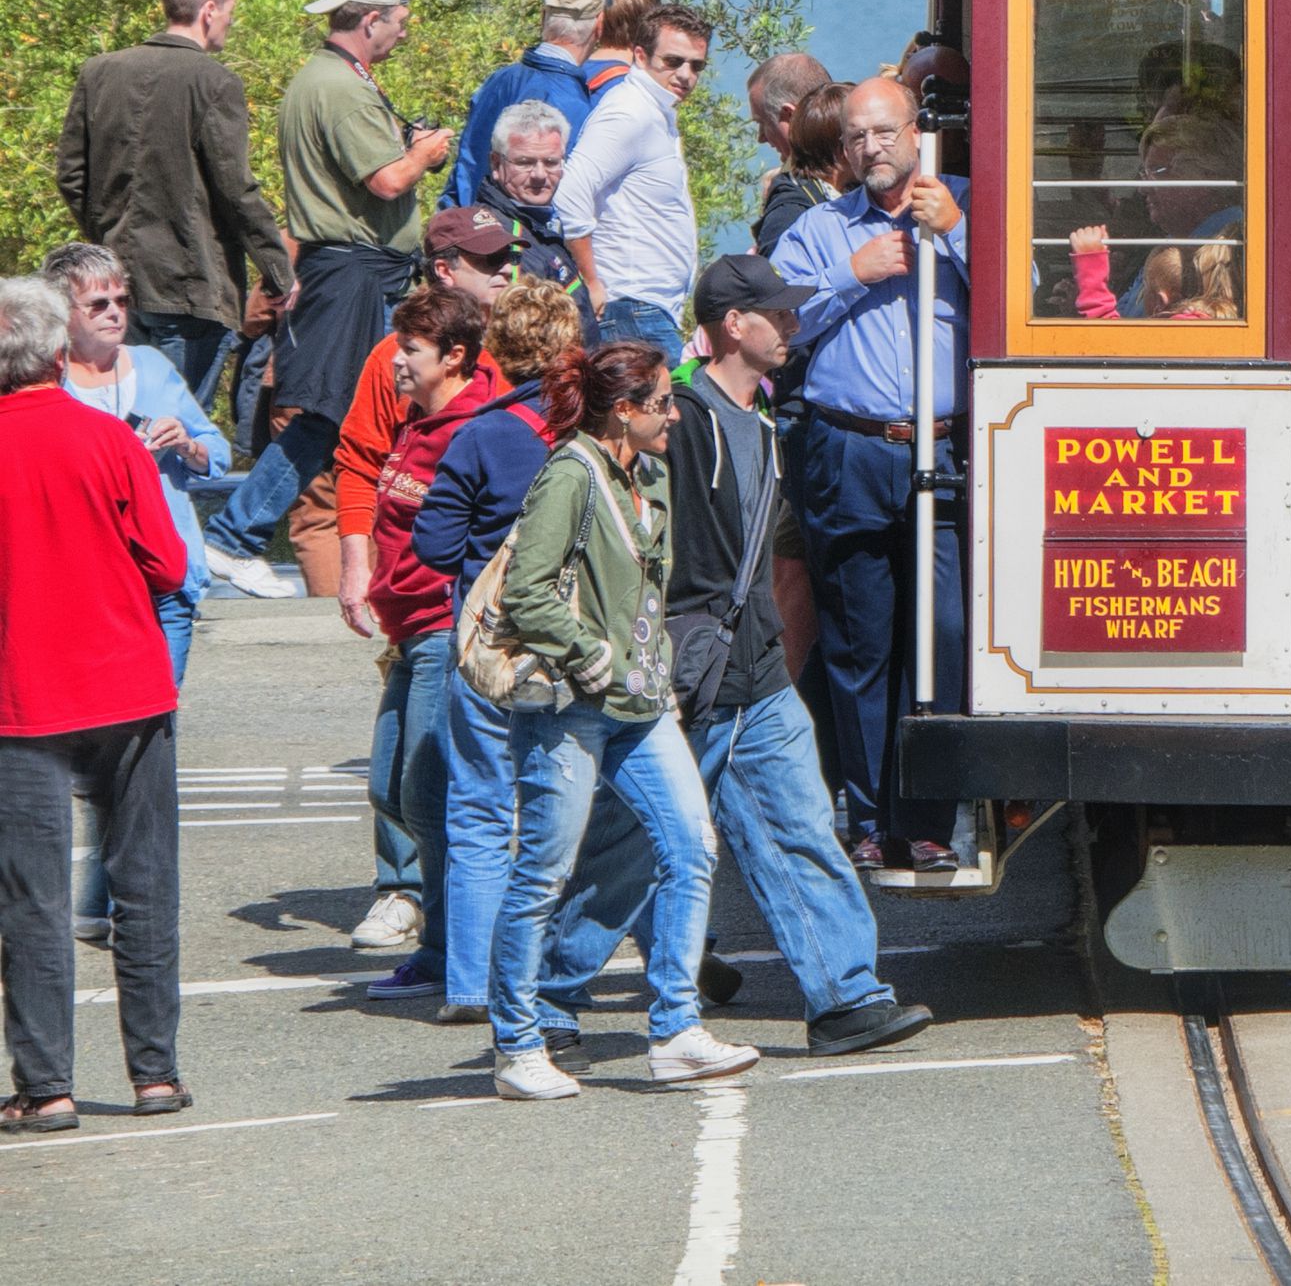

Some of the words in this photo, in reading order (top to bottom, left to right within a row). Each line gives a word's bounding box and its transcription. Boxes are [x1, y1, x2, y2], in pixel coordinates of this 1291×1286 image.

[1056, 438, 1236, 464] POWELL
[1103, 467, 1194, 488] AND
[1053, 489, 1240, 515] MARKET
[1054, 559, 1116, 588] HYDE
[1121, 559, 1152, 588] AND
[1156, 557, 1237, 588] BEACH
[1069, 595, 1222, 617] FISHERMANS
[1105, 618, 1184, 639] WHARF
